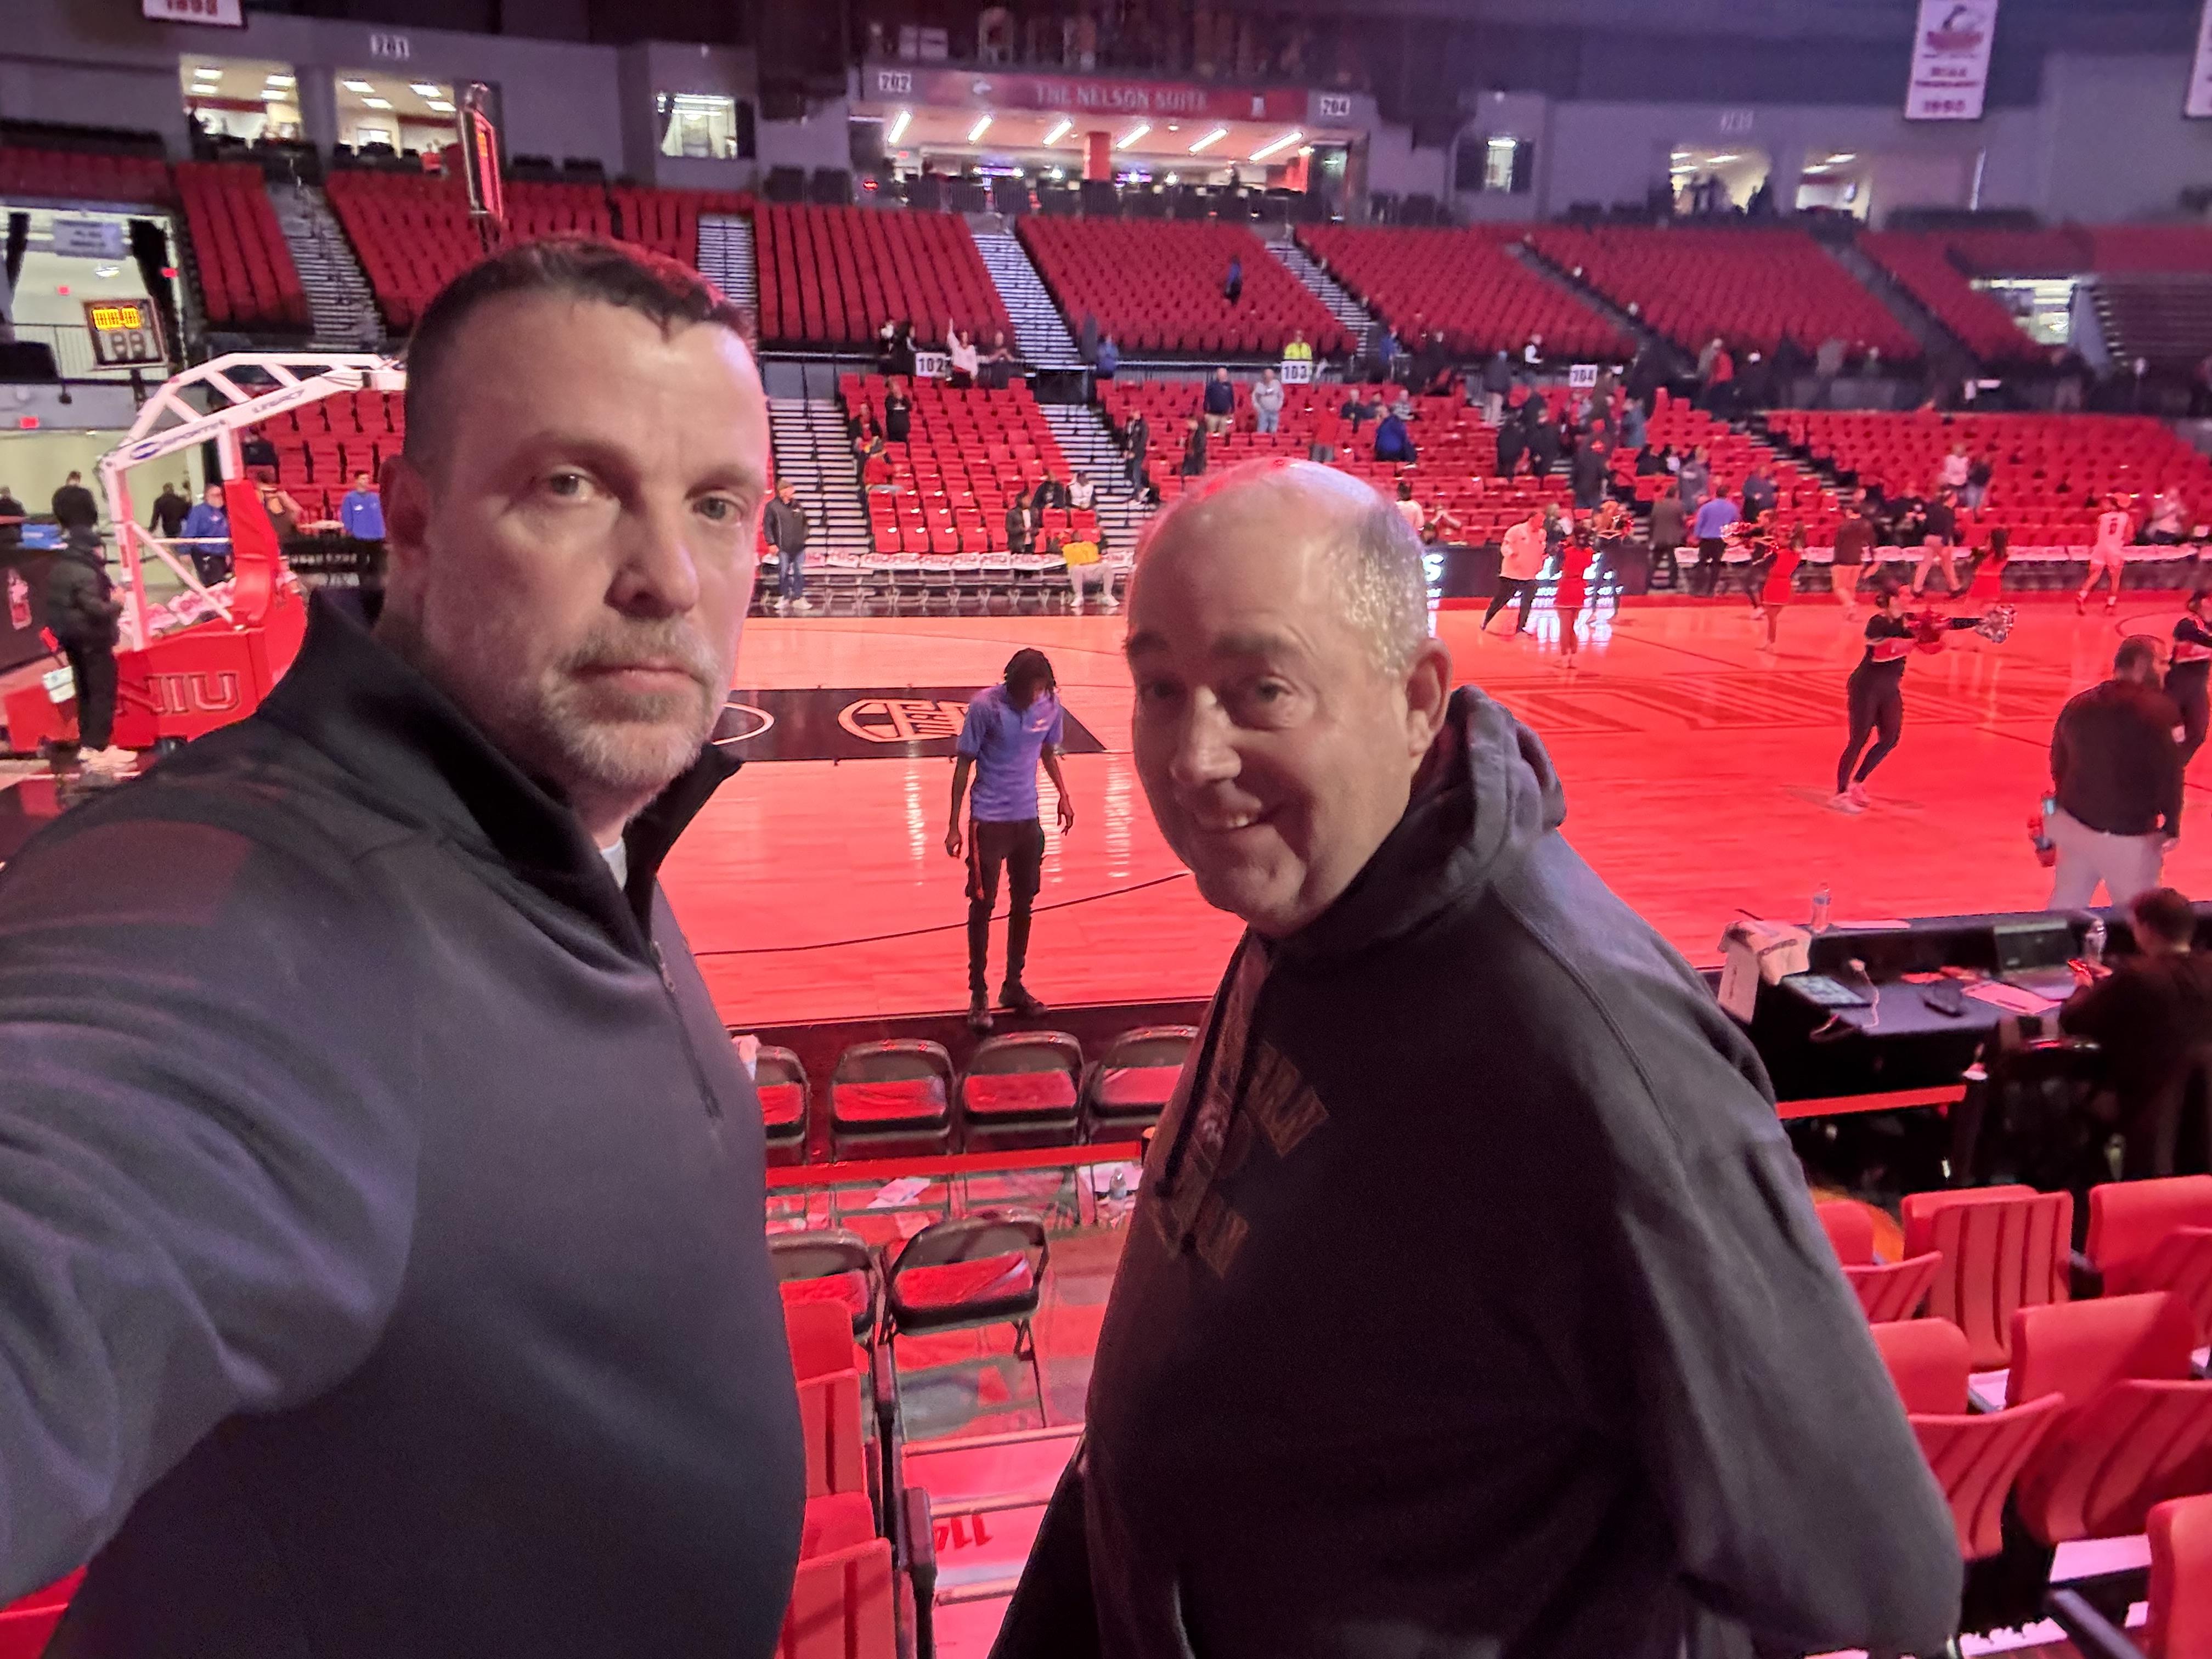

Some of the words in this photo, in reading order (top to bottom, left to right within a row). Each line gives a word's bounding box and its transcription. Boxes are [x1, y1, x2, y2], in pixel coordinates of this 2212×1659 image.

[1076, 83, 1150, 109] NELSON
[919, 358, 944, 373] 102
[1285, 365, 1307, 380] 103
[114, 672, 240, 715] NIU
